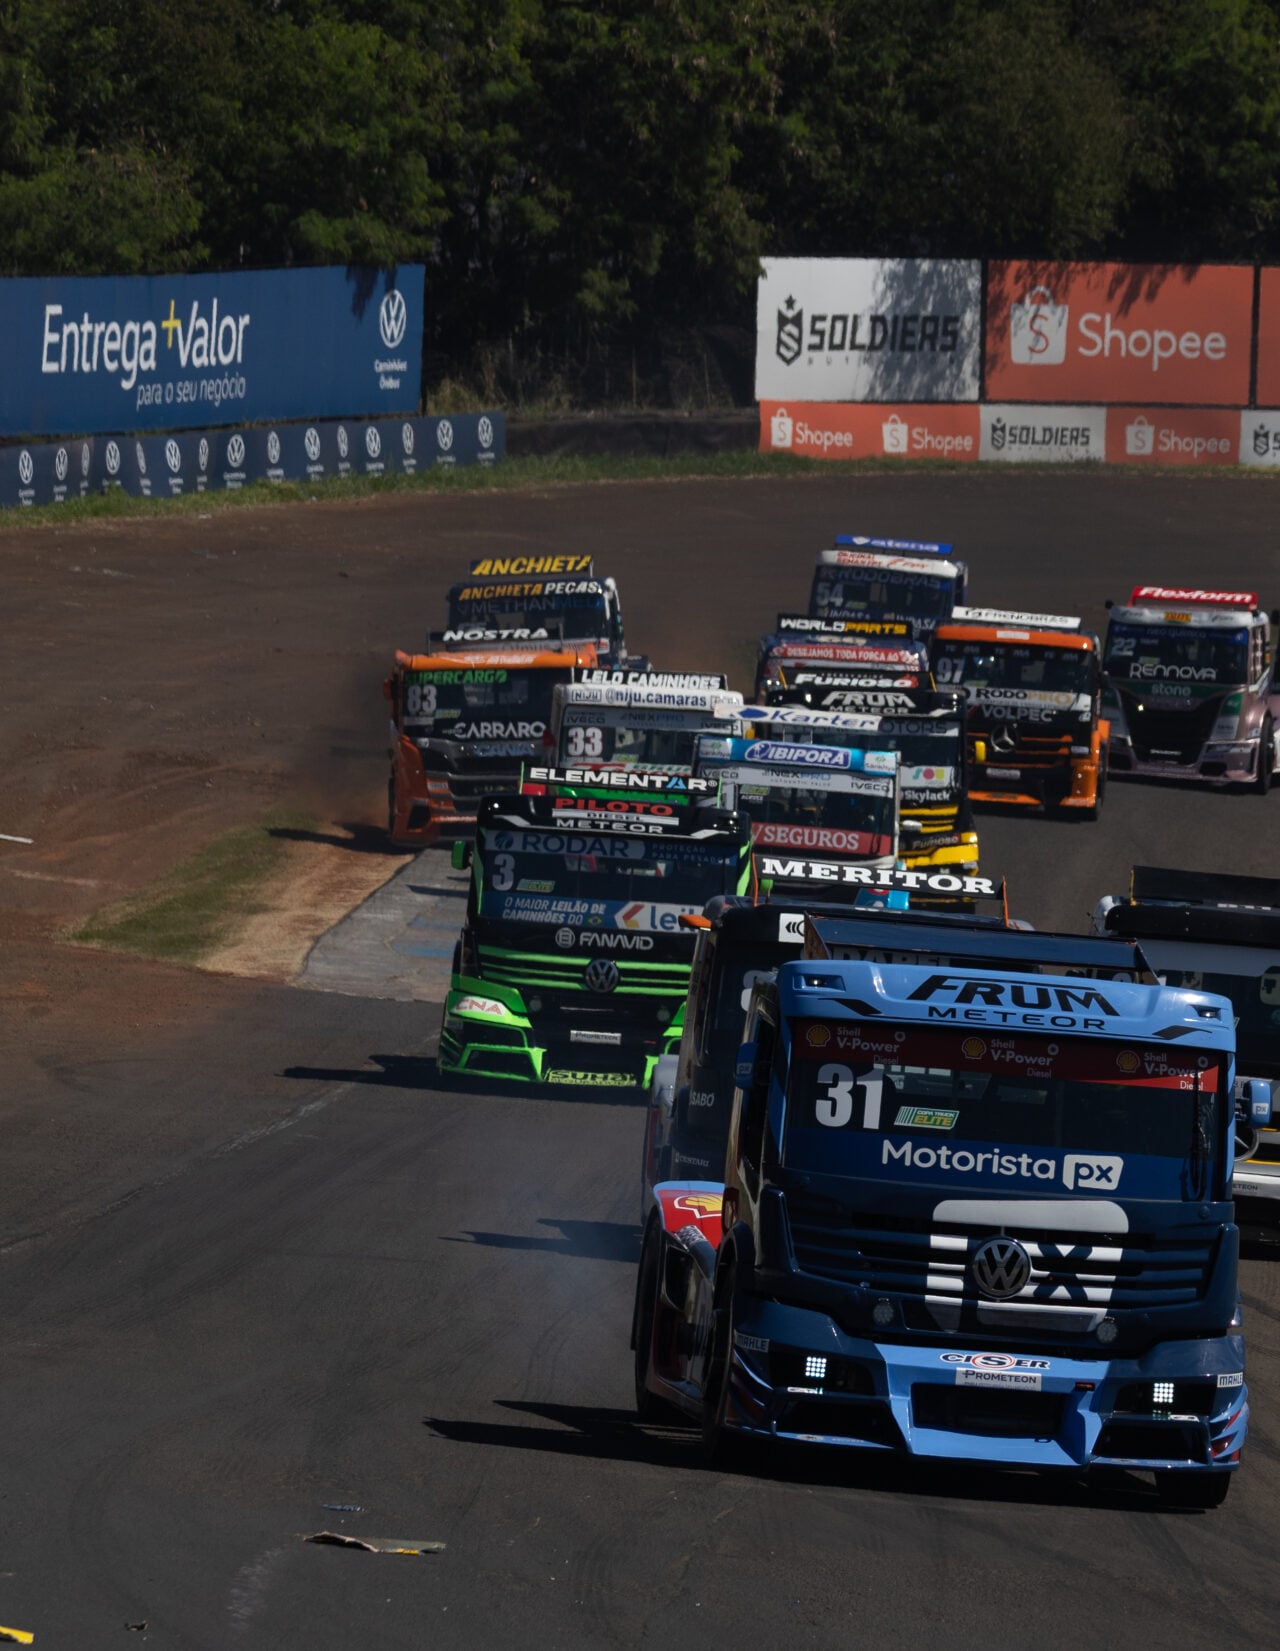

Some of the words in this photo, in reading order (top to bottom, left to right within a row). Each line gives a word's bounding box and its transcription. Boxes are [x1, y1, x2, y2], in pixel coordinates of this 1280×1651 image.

[807, 314, 960, 352] SOLDIERS
[1078, 313, 1227, 372] Shopee
[42, 304, 157, 390] Entrega
[136, 384, 163, 412] para
[165, 382, 174, 404] o
[176, 380, 198, 403] seu
[199, 371, 246, 408] negócio
[795, 422, 854, 452] Shopee
[911, 428, 974, 456] Shopee
[1007, 425, 1091, 447] SOLDIERS
[1158, 429, 1231, 455] Shopee
[471, 554, 593, 576] ANCHIETA
[459, 583, 545, 601] ANCHIETA
[442, 627, 549, 642] NOSTRA
[835, 648, 857, 660] TODA
[887, 652, 900, 662] AO
[581, 669, 624, 684] LELO
[936, 656, 966, 684] 97
[407, 684, 438, 717] 83
[820, 691, 917, 709] FRUM
[770, 710, 876, 729] Karter
[982, 704, 1053, 722] VOLPEC
[454, 720, 547, 739] CARRARO
[876, 720, 949, 734] OTORS
[567, 726, 603, 757] 33
[850, 782, 890, 793] IVECO
[554, 797, 675, 817] PILOTO
[556, 818, 664, 834] METEOR
[521, 834, 631, 858] RODAR
[763, 824, 860, 850] SEGUROS
[491, 853, 516, 892] 3
[761, 857, 996, 894] MERITOR
[504, 897, 512, 907] O
[514, 898, 550, 912] MAIOR
[551, 900, 590, 914] LEILÃO
[590, 903, 607, 915] DE
[501, 908, 565, 924] CAMINHÕES
[567, 914, 584, 926] DO
[578, 930, 655, 950] FANAVID
[907, 974, 1120, 1017] FRUM
[927, 1005, 1107, 1031] METEOR
[836, 1026, 861, 1037] Shell
[836, 1037, 901, 1053] V-Power
[990, 1038, 1015, 1050] Shell
[873, 1054, 900, 1065] Diesel
[990, 1049, 1054, 1066] V-Power
[1143, 1051, 1167, 1063] Shell
[1026, 1067, 1053, 1079] Diesel
[1143, 1062, 1204, 1079] V-Power
[1179, 1079, 1204, 1091] Dieel
[815, 1062, 883, 1130] 31
[1255, 1105, 1268, 1115] px
[913, 1115, 954, 1127] ELITE
[881, 1138, 1056, 1180] Motorista
[1232, 1183, 1258, 1191] ETEON
